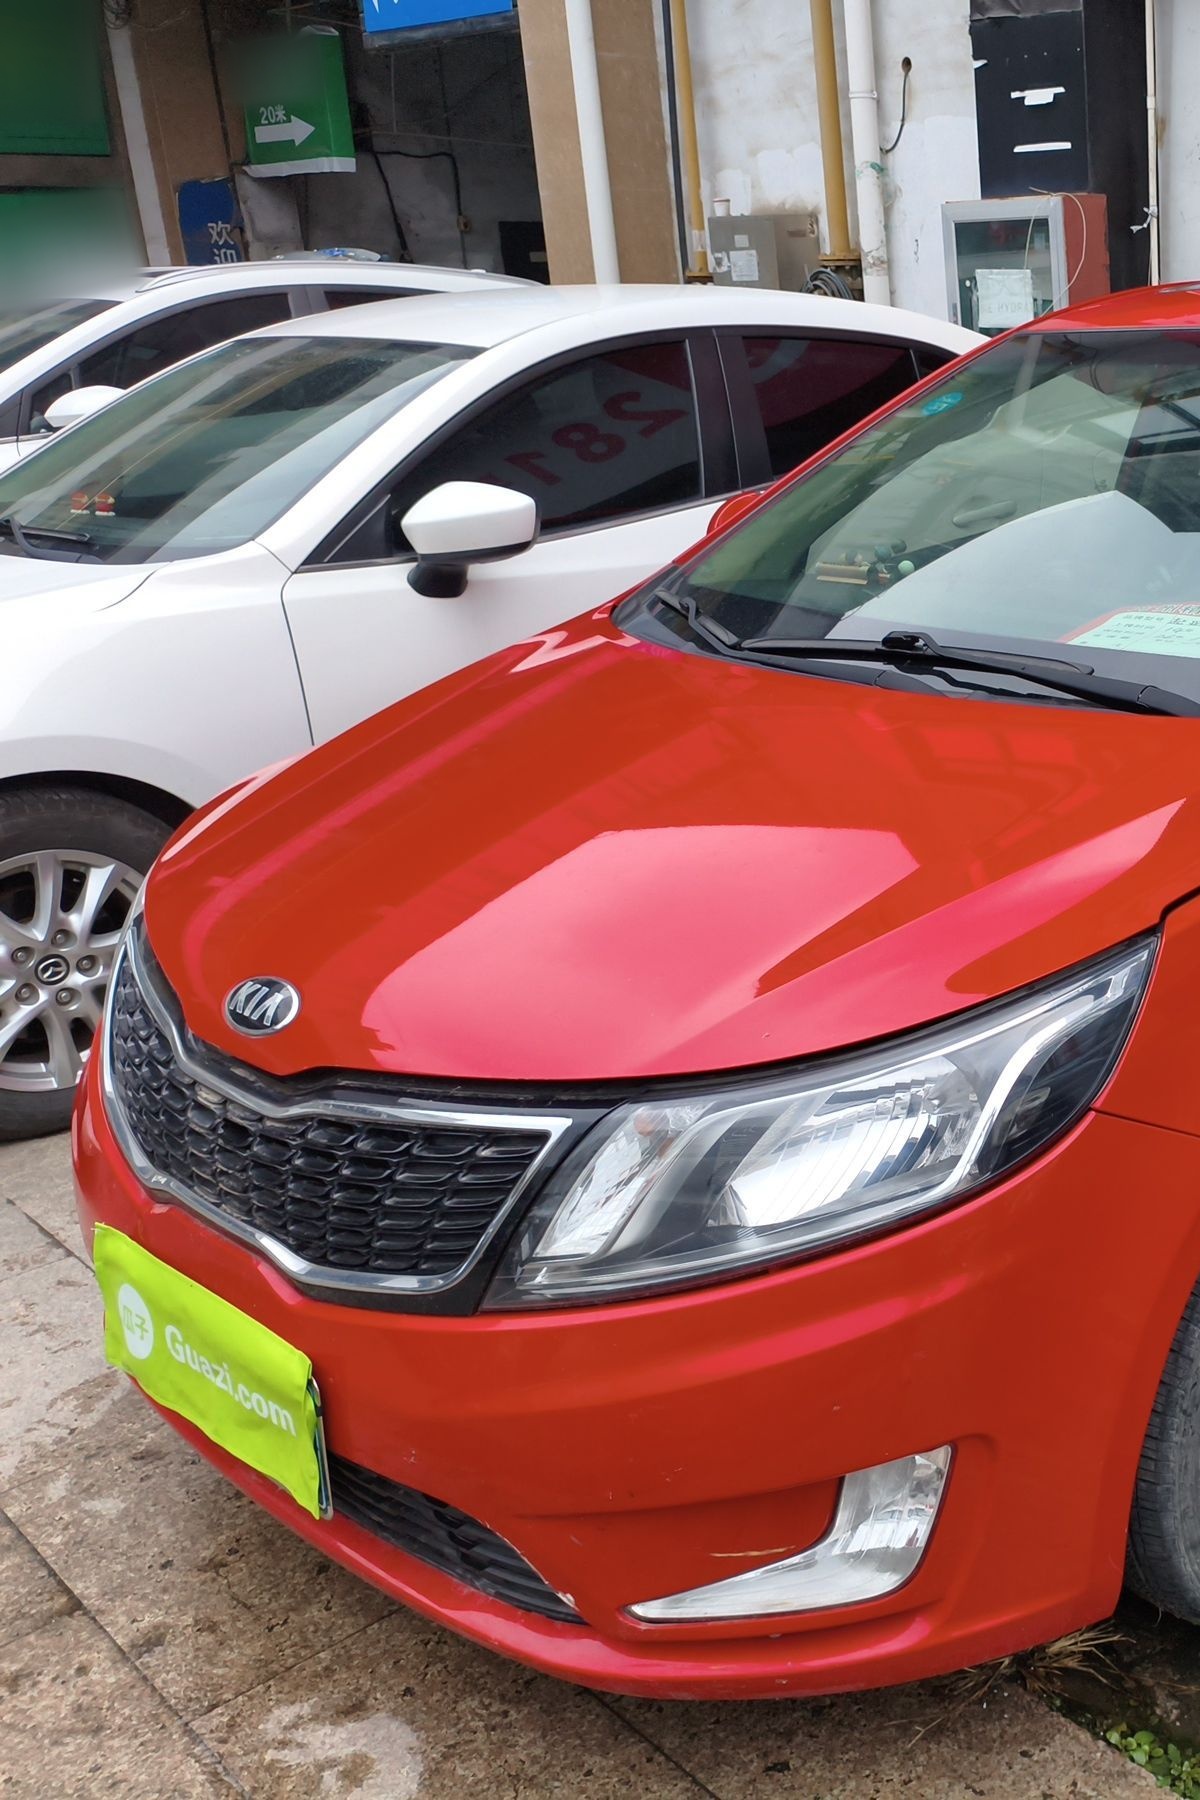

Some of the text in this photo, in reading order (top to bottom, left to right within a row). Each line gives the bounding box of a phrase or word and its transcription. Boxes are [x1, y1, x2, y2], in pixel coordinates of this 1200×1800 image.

[259, 104, 287, 124] 20米
[229, 981, 284, 1027] KIA
[122, 1304, 150, 1341] 瓜子
[165, 1324, 297, 1438] Guazi.com
